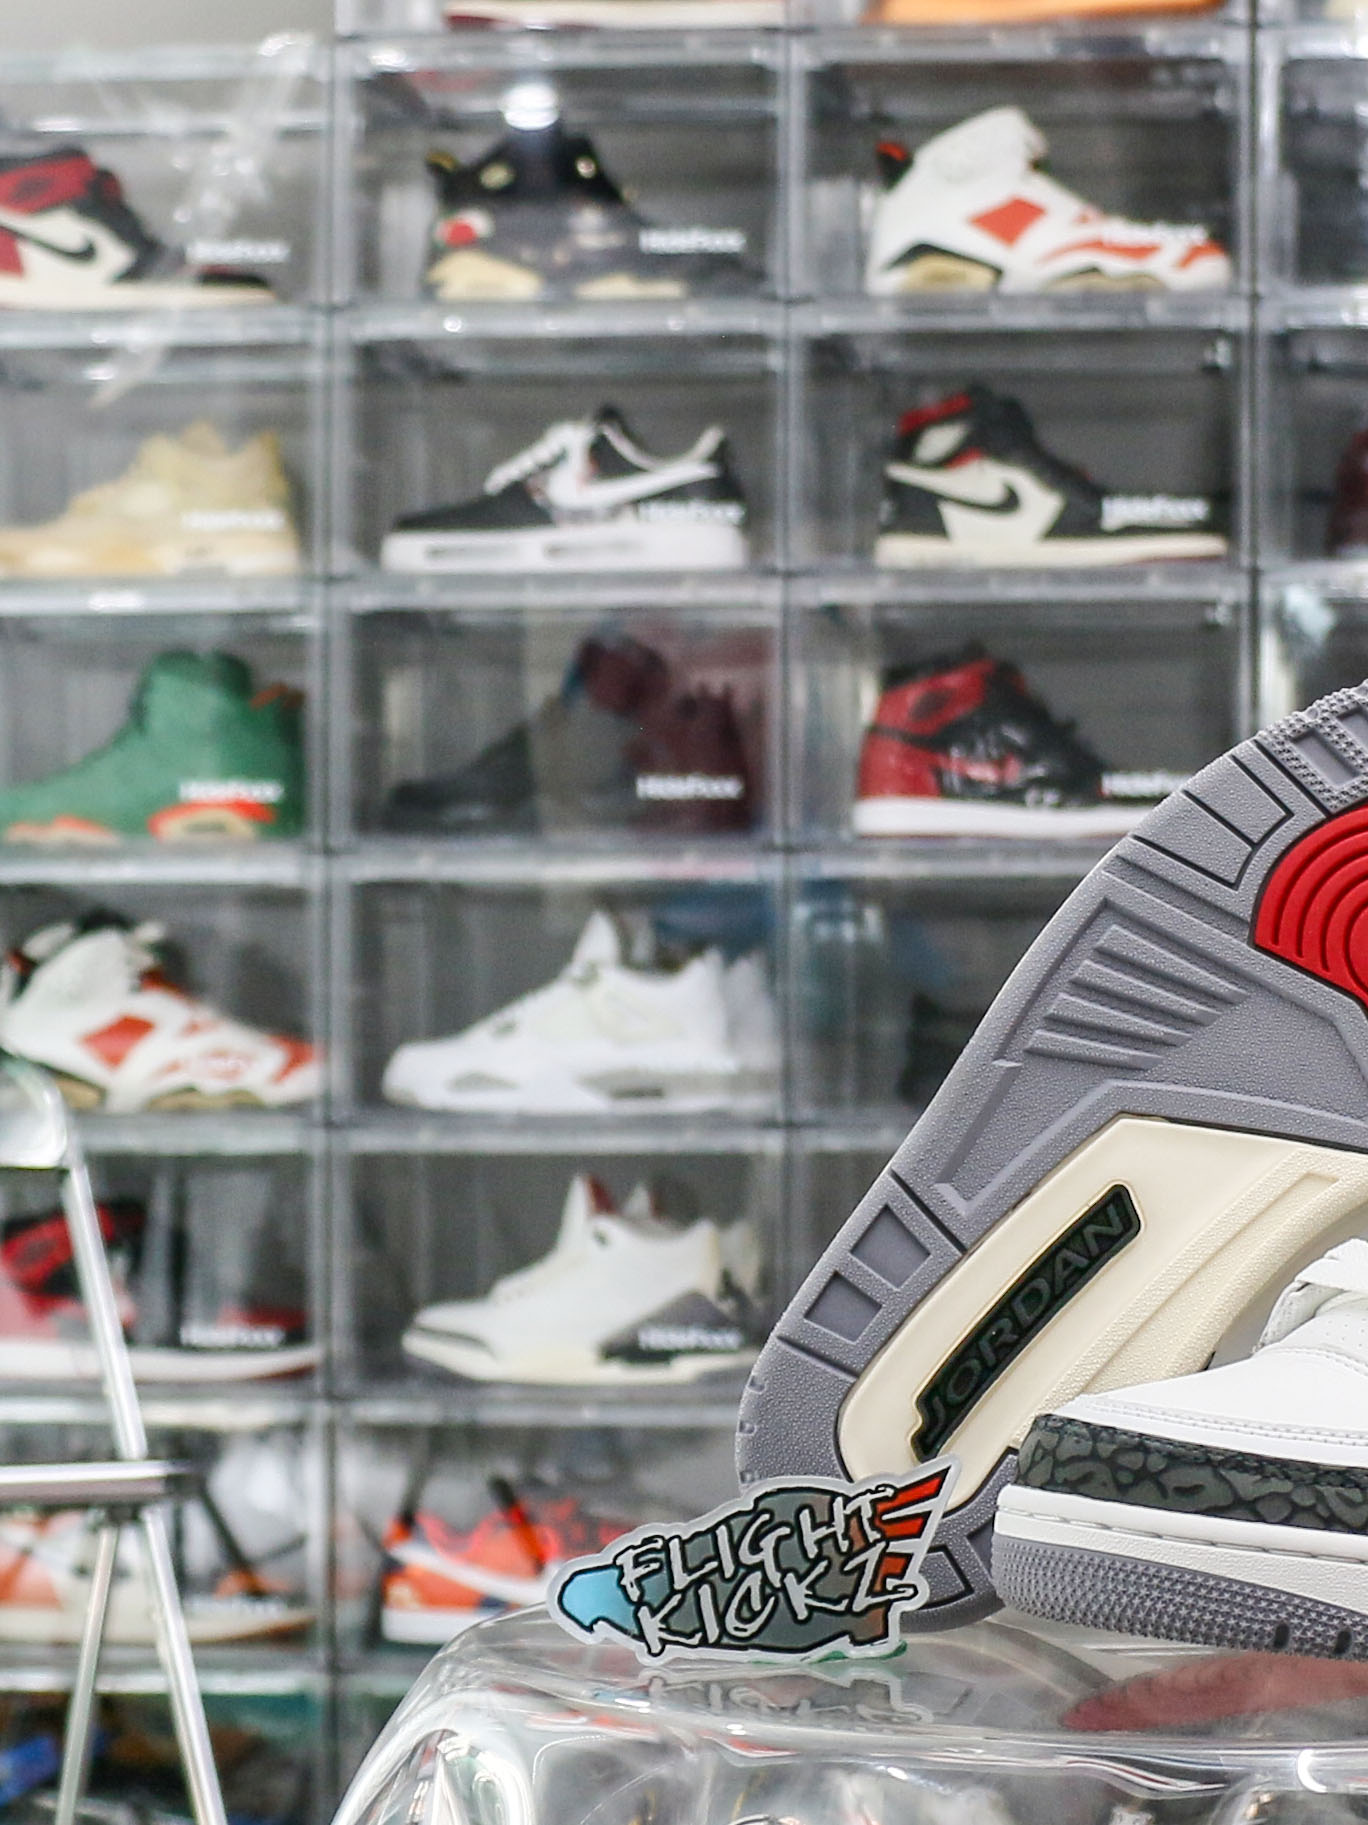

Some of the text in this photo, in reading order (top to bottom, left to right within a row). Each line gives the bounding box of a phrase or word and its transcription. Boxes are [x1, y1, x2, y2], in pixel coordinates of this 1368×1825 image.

[924, 1204, 1125, 1446] JORDAN
[617, 1486, 894, 1602] FLIGHT
[638, 1541, 917, 1655] KICKZ
